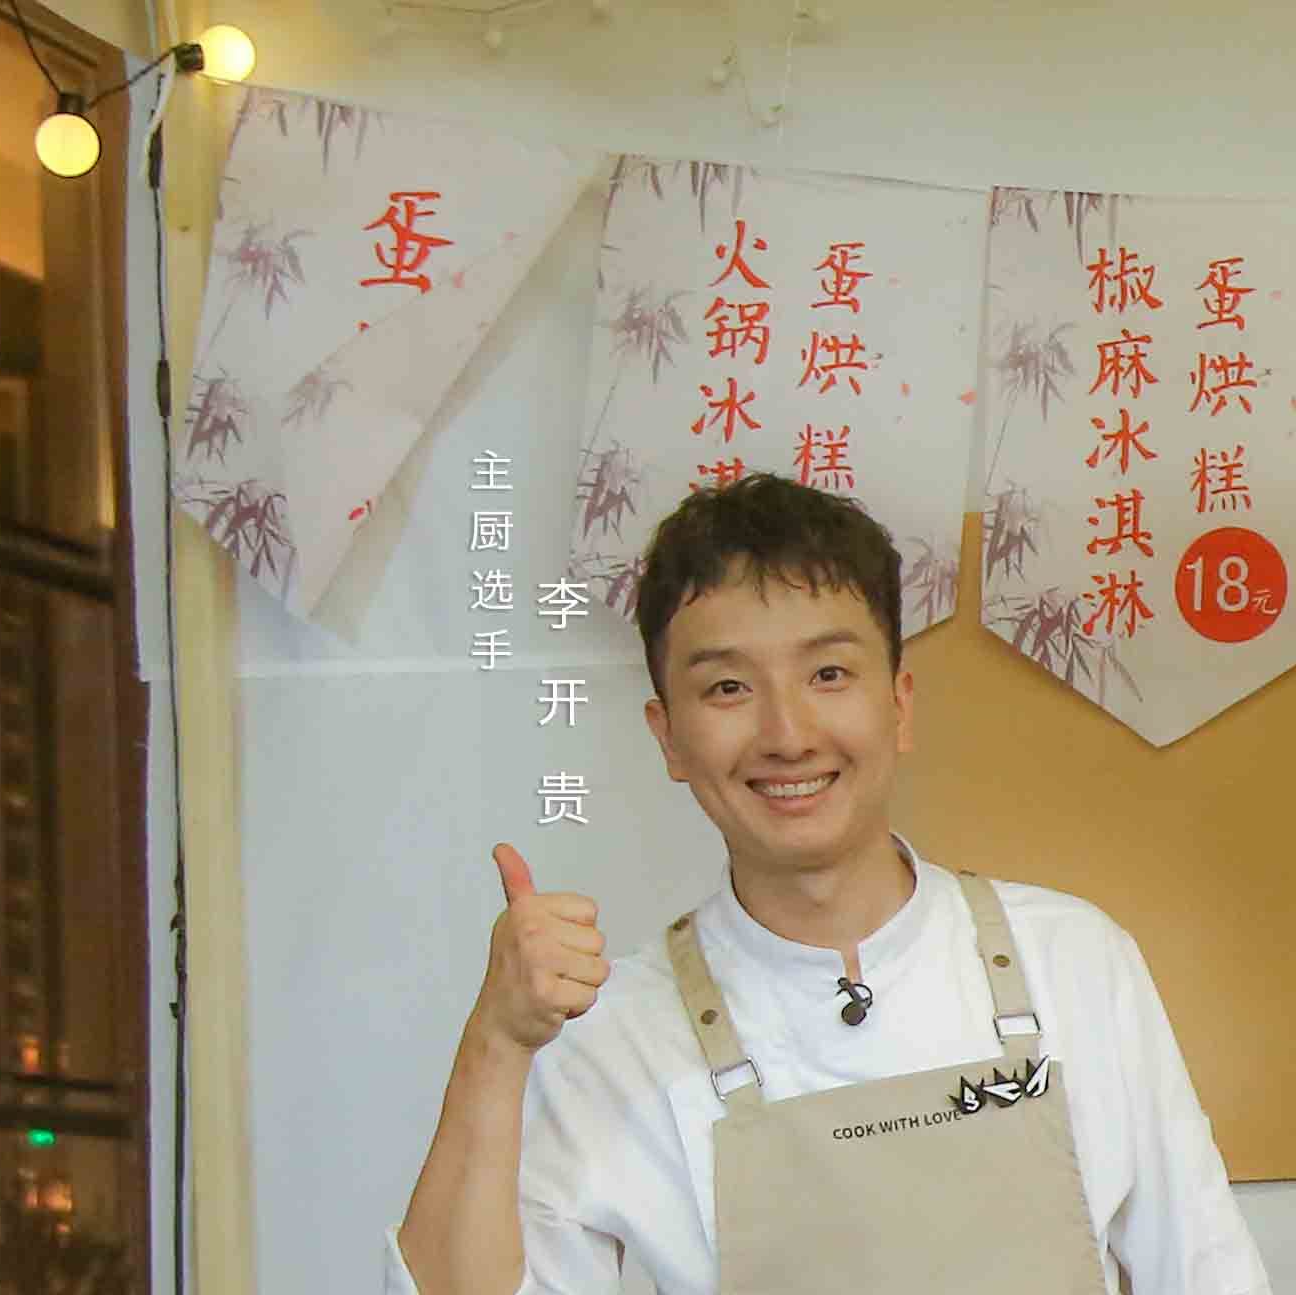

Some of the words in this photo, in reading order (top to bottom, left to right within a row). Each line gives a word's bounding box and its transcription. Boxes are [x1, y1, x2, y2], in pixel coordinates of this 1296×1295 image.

[360, 191, 455, 294] 蛋
[791, 241, 874, 490] 蛋烘糕
[1081, 247, 1163, 640] 椒麻冰淇淋
[1189, 256, 1258, 514] 蛋烘糕
[832, 1123, 876, 1141] COOK
[879, 1116, 921, 1136] WITH
